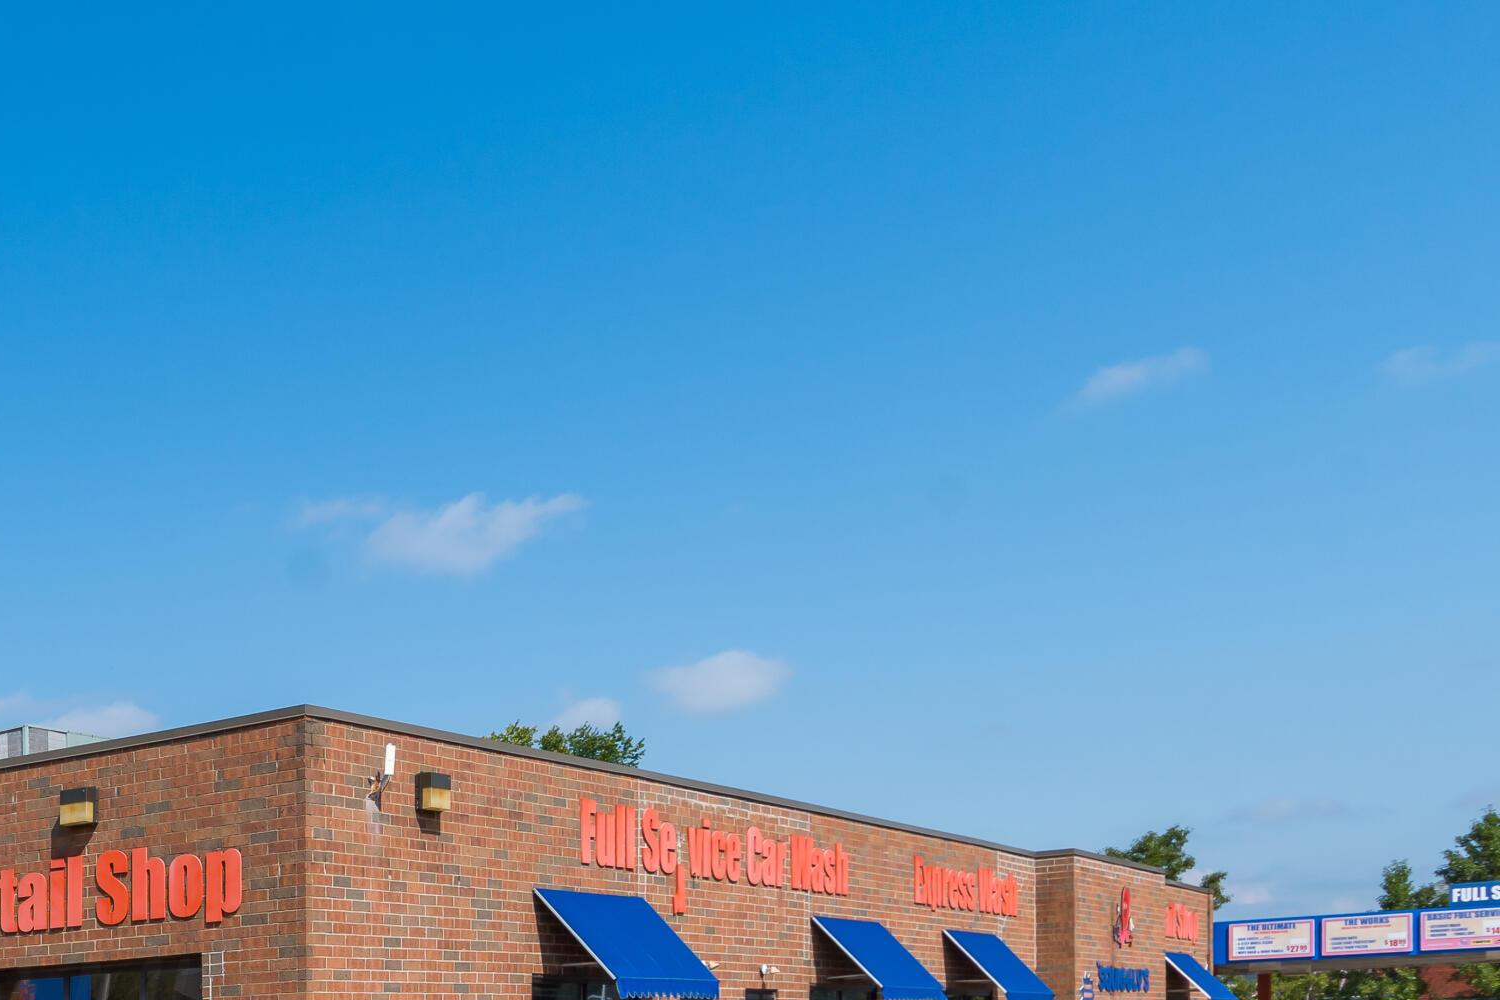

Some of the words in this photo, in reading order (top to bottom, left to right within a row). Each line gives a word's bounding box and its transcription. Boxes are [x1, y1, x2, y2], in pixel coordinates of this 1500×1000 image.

[579, 797, 637, 872] Full
[746, 826, 787, 889] Car
[790, 832, 850, 896] Wash
[95, 846, 243, 926] Shop
[913, 854, 976, 912] Express
[1452, 886, 1489, 903] FULL
